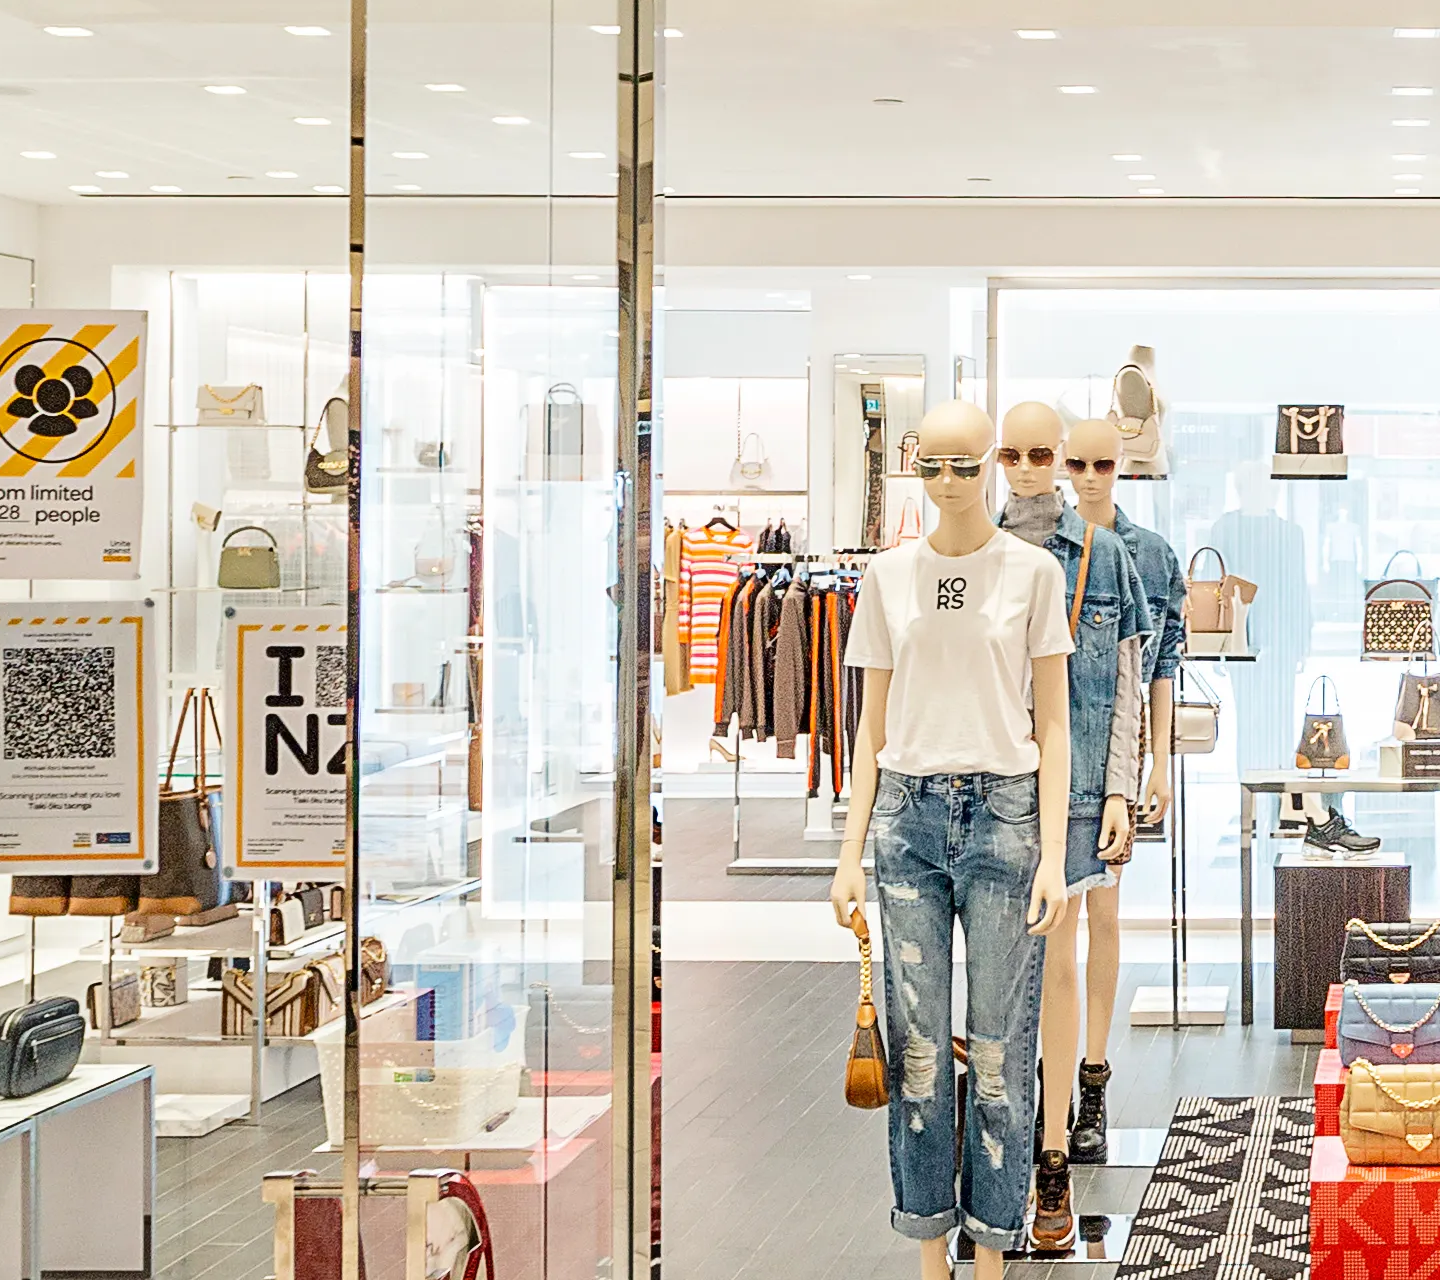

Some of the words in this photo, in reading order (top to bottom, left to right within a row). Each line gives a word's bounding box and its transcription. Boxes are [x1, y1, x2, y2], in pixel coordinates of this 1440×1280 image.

[30, 484, 93, 501] limited
[35, 506, 101, 526] people
[937, 576, 967, 594] KO
[936, 594, 964, 610] RS
[265, 646, 305, 707] I
[0, 791, 34, 800] Scanning
[35, 792, 67, 800] protects
[90, 791, 103, 799] you
